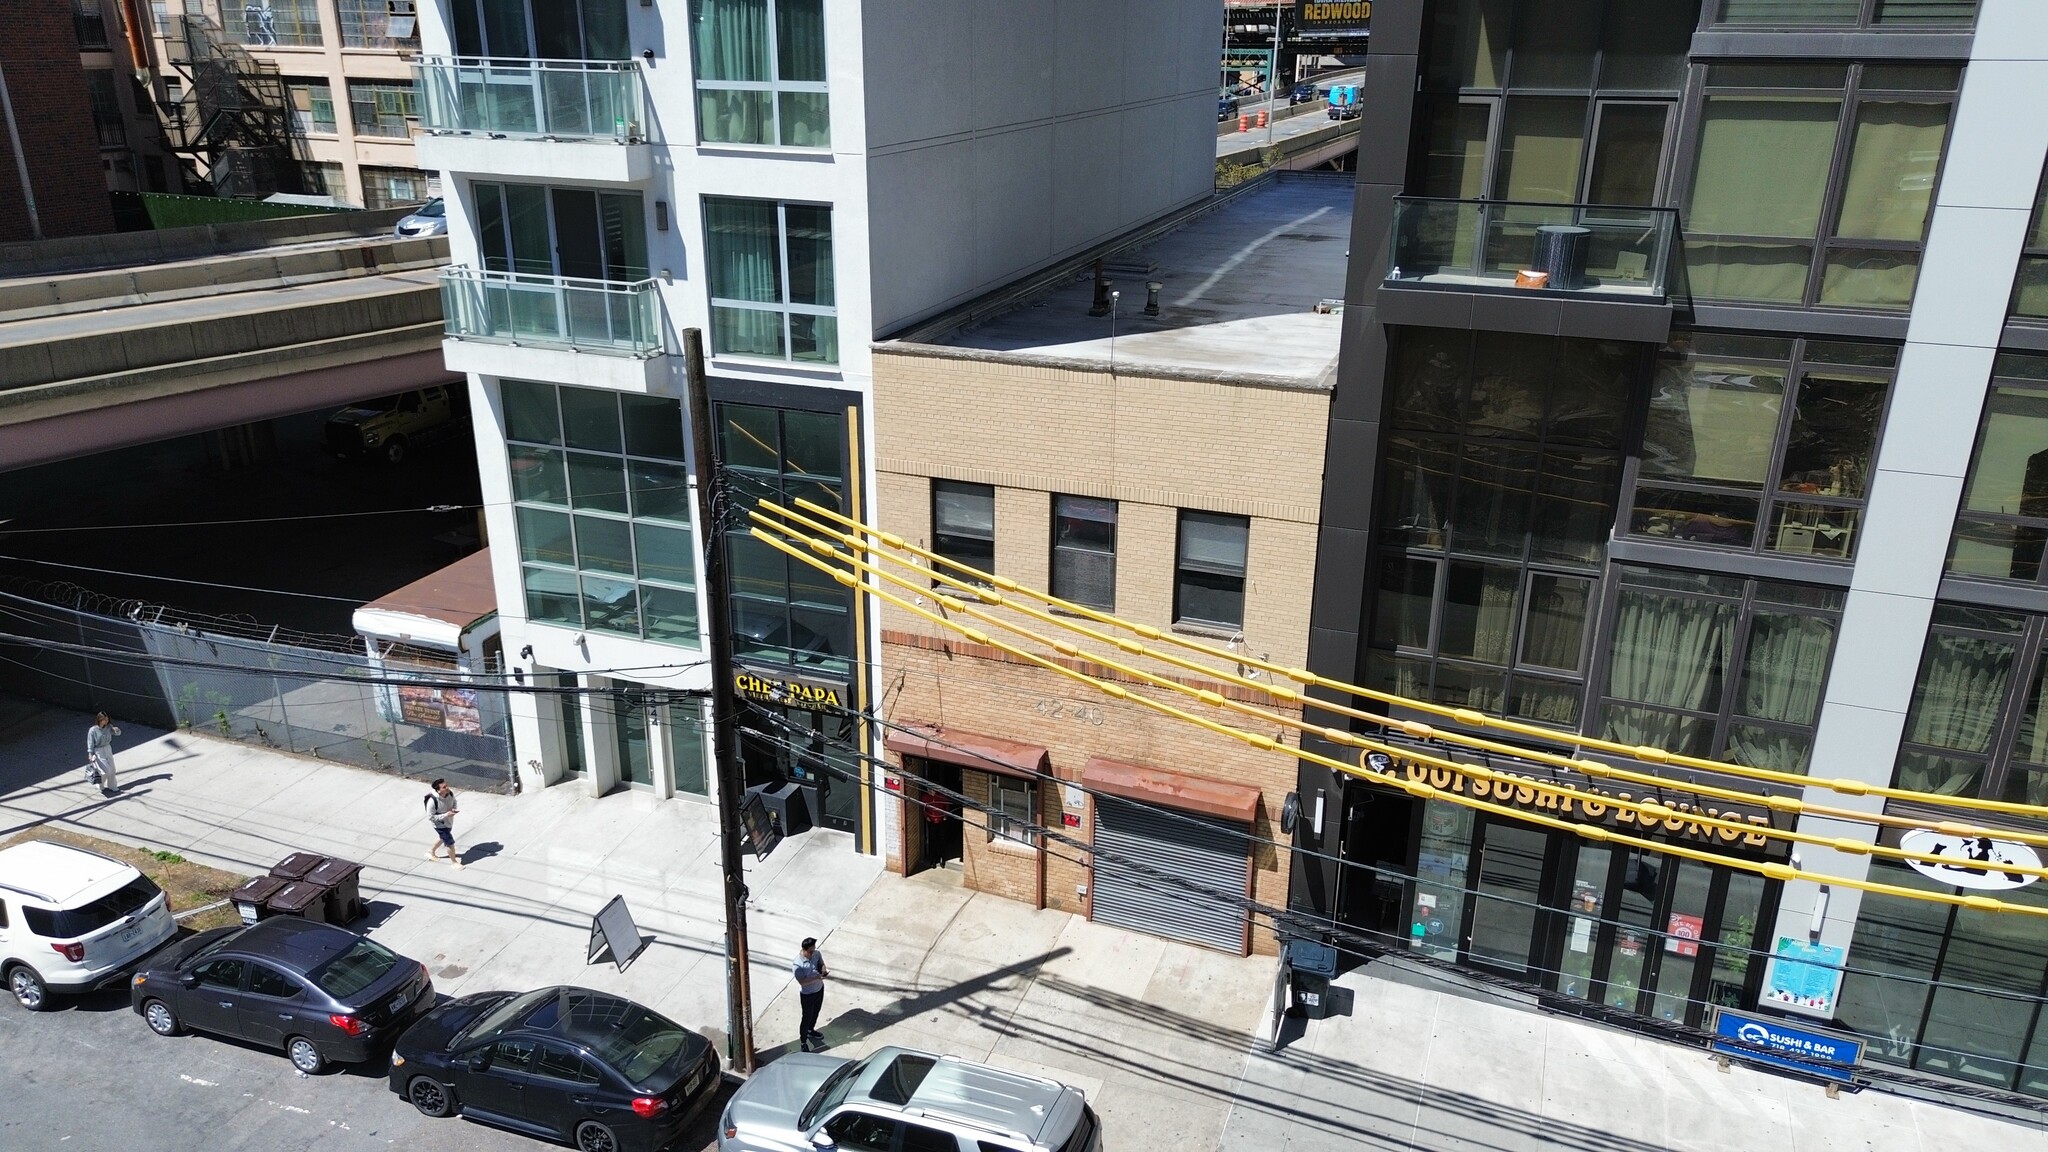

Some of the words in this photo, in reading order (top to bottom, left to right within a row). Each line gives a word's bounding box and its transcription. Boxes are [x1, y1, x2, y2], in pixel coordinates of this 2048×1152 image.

[1304, 2, 1370, 19] REDWOOD
[736, 675, 782, 695] CHE
[788, 683, 839, 706] PAPA
[1472, 770, 1576, 812] SUSHI
[1615, 793, 1770, 847] LOUNGE
[1769, 1033, 1803, 1048] SUSHI
[1804, 1041, 1812, 1050] &
[1814, 1043, 1835, 1055] BAR
